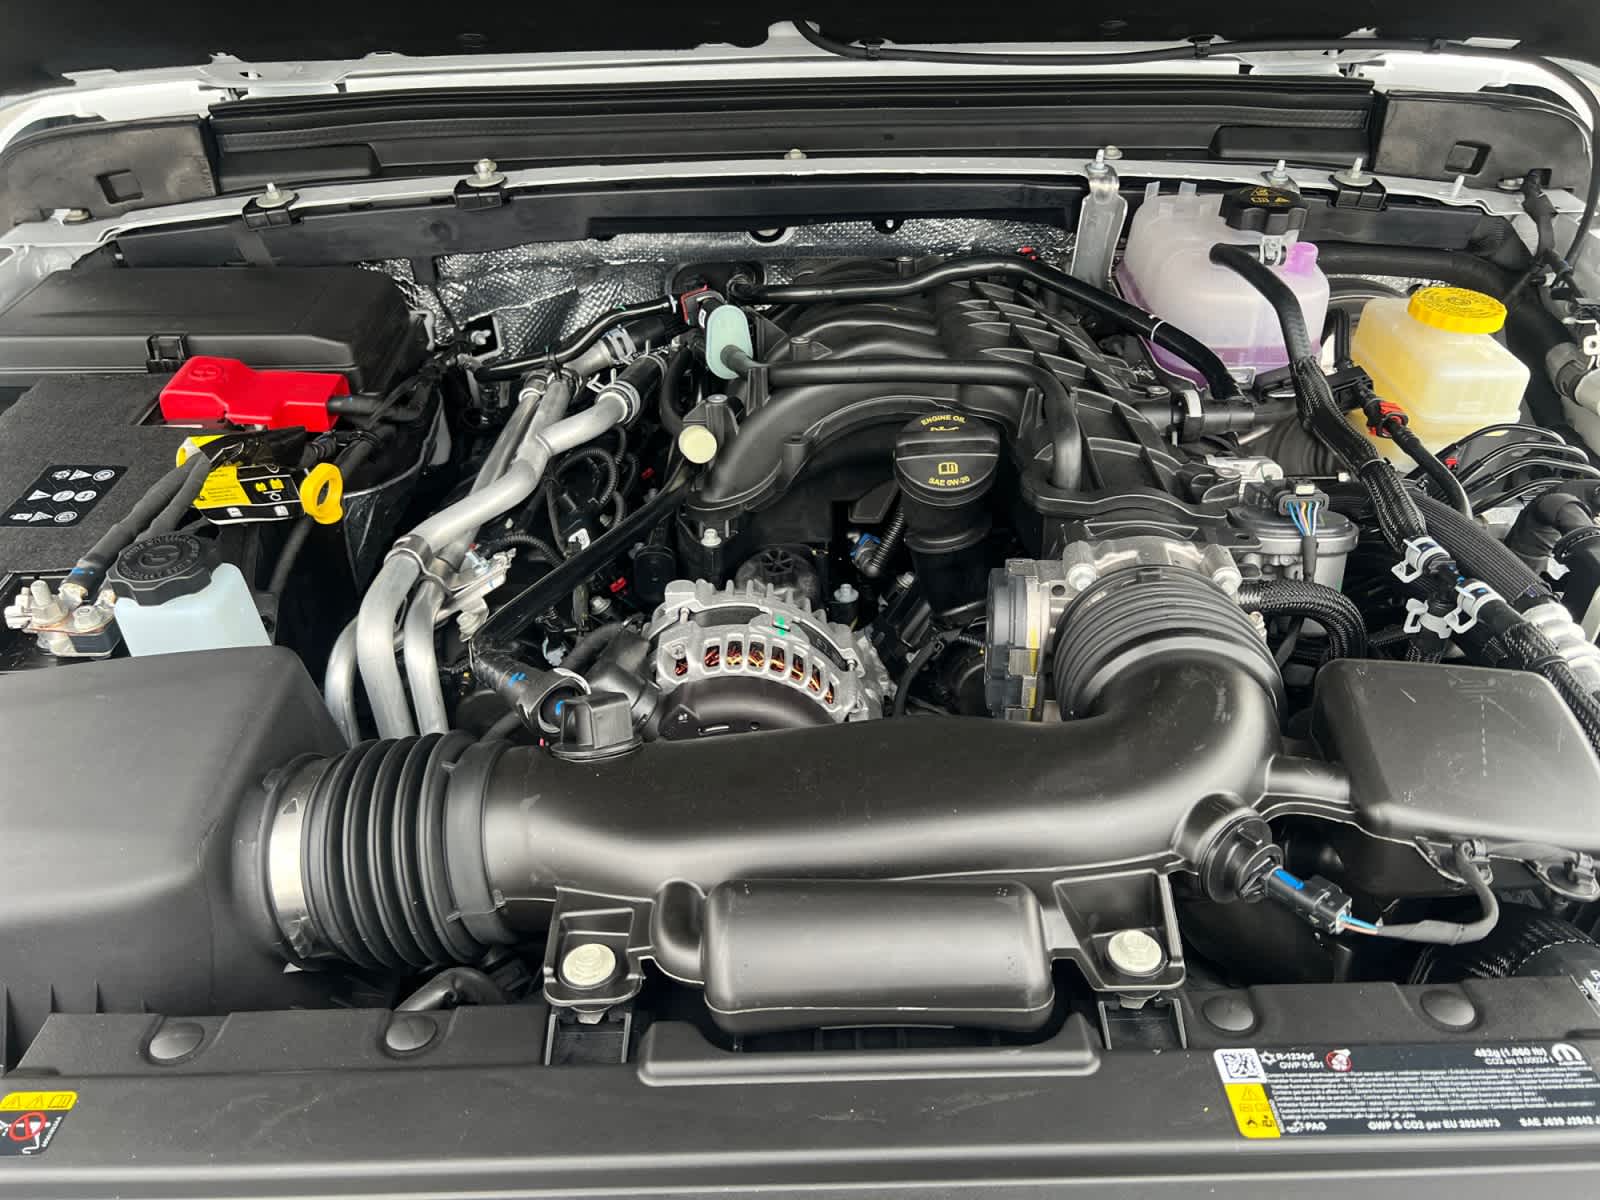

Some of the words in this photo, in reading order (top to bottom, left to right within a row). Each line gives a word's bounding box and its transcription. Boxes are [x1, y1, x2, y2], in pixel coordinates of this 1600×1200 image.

[921, 415, 952, 426] ENGINE
[952, 415, 966, 424] OIL
[928, 477, 945, 486] SAE
